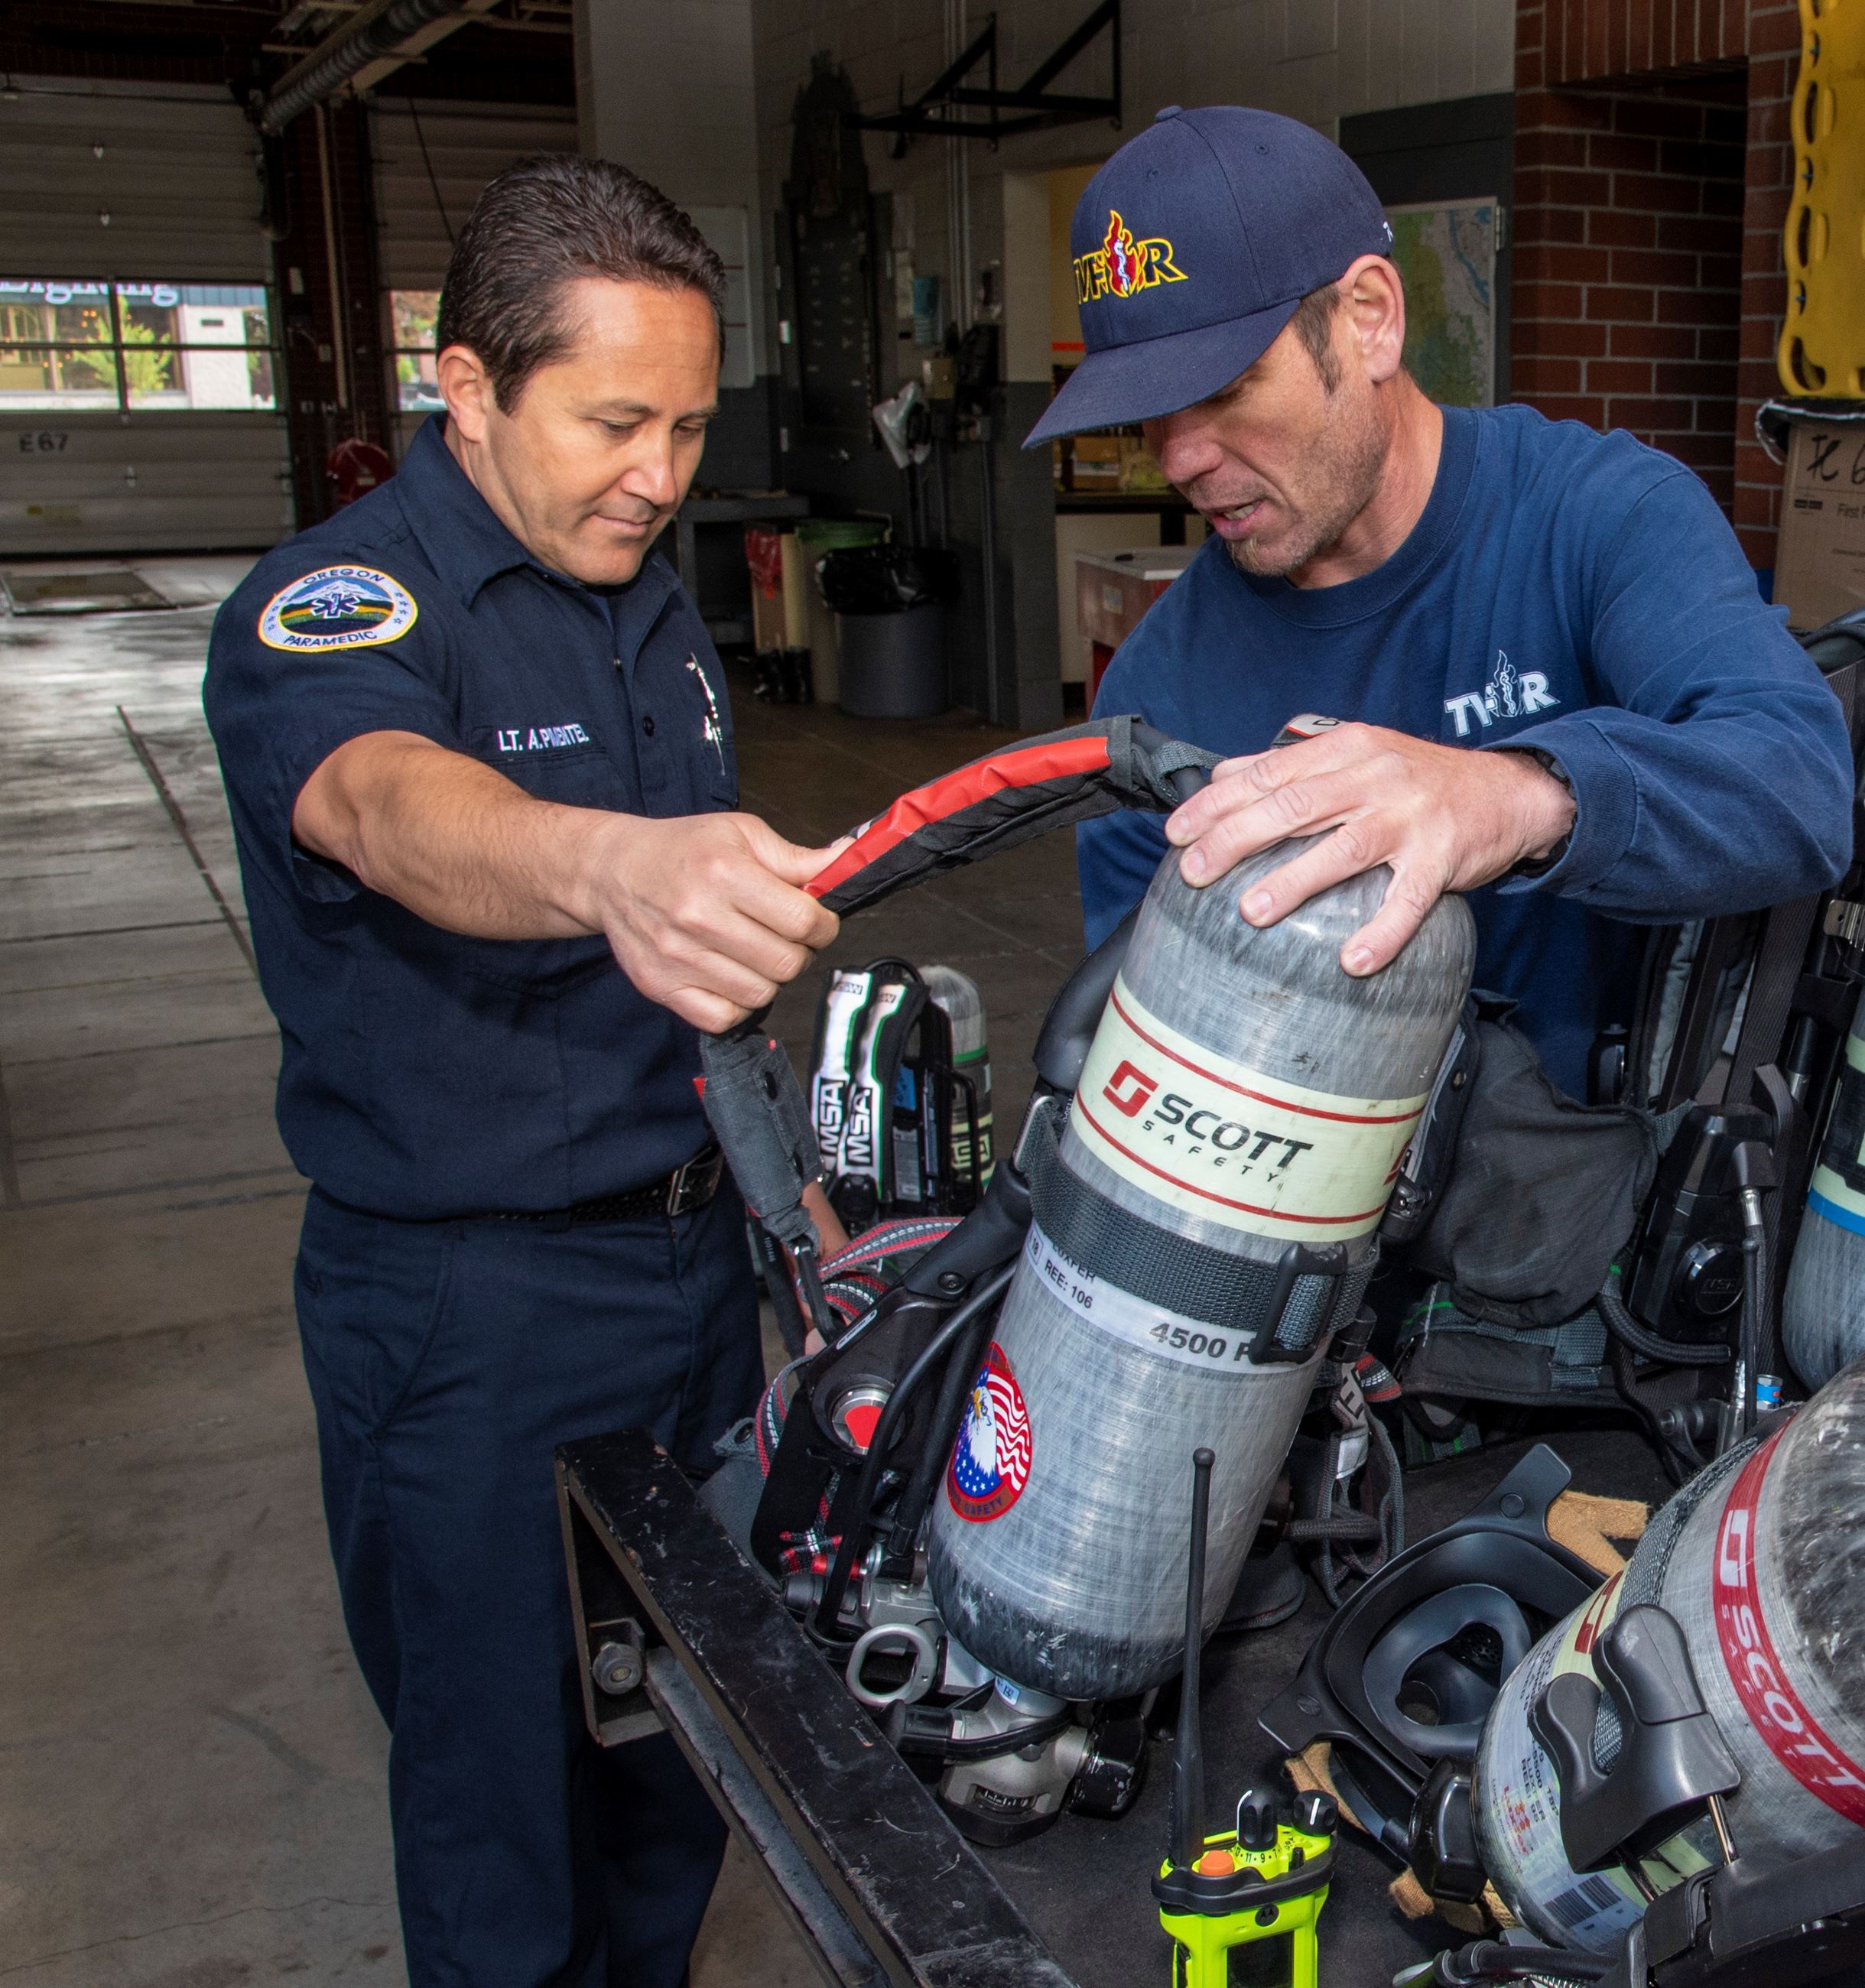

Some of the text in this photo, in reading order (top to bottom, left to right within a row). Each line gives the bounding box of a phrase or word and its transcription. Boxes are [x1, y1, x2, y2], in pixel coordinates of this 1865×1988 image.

[304, 568, 385, 585] OREGON
[283, 631, 378, 648] PARAMEDIC
[497, 729, 524, 752] LT.
[820, 1078, 844, 1154] MSA
[846, 1087, 872, 1165] MSA
[1153, 1093, 1315, 1169] SCOTT
[1142, 1119, 1279, 1183] SAFETY
[1045, 1259, 1093, 1309] REE: 106
[1149, 1322, 1227, 1359] 4500
[1720, 1603, 1827, 1787] SAFETY
[1731, 1604, 1865, 1791] SCOTT
[1260, 1853, 1266, 1863] 9
